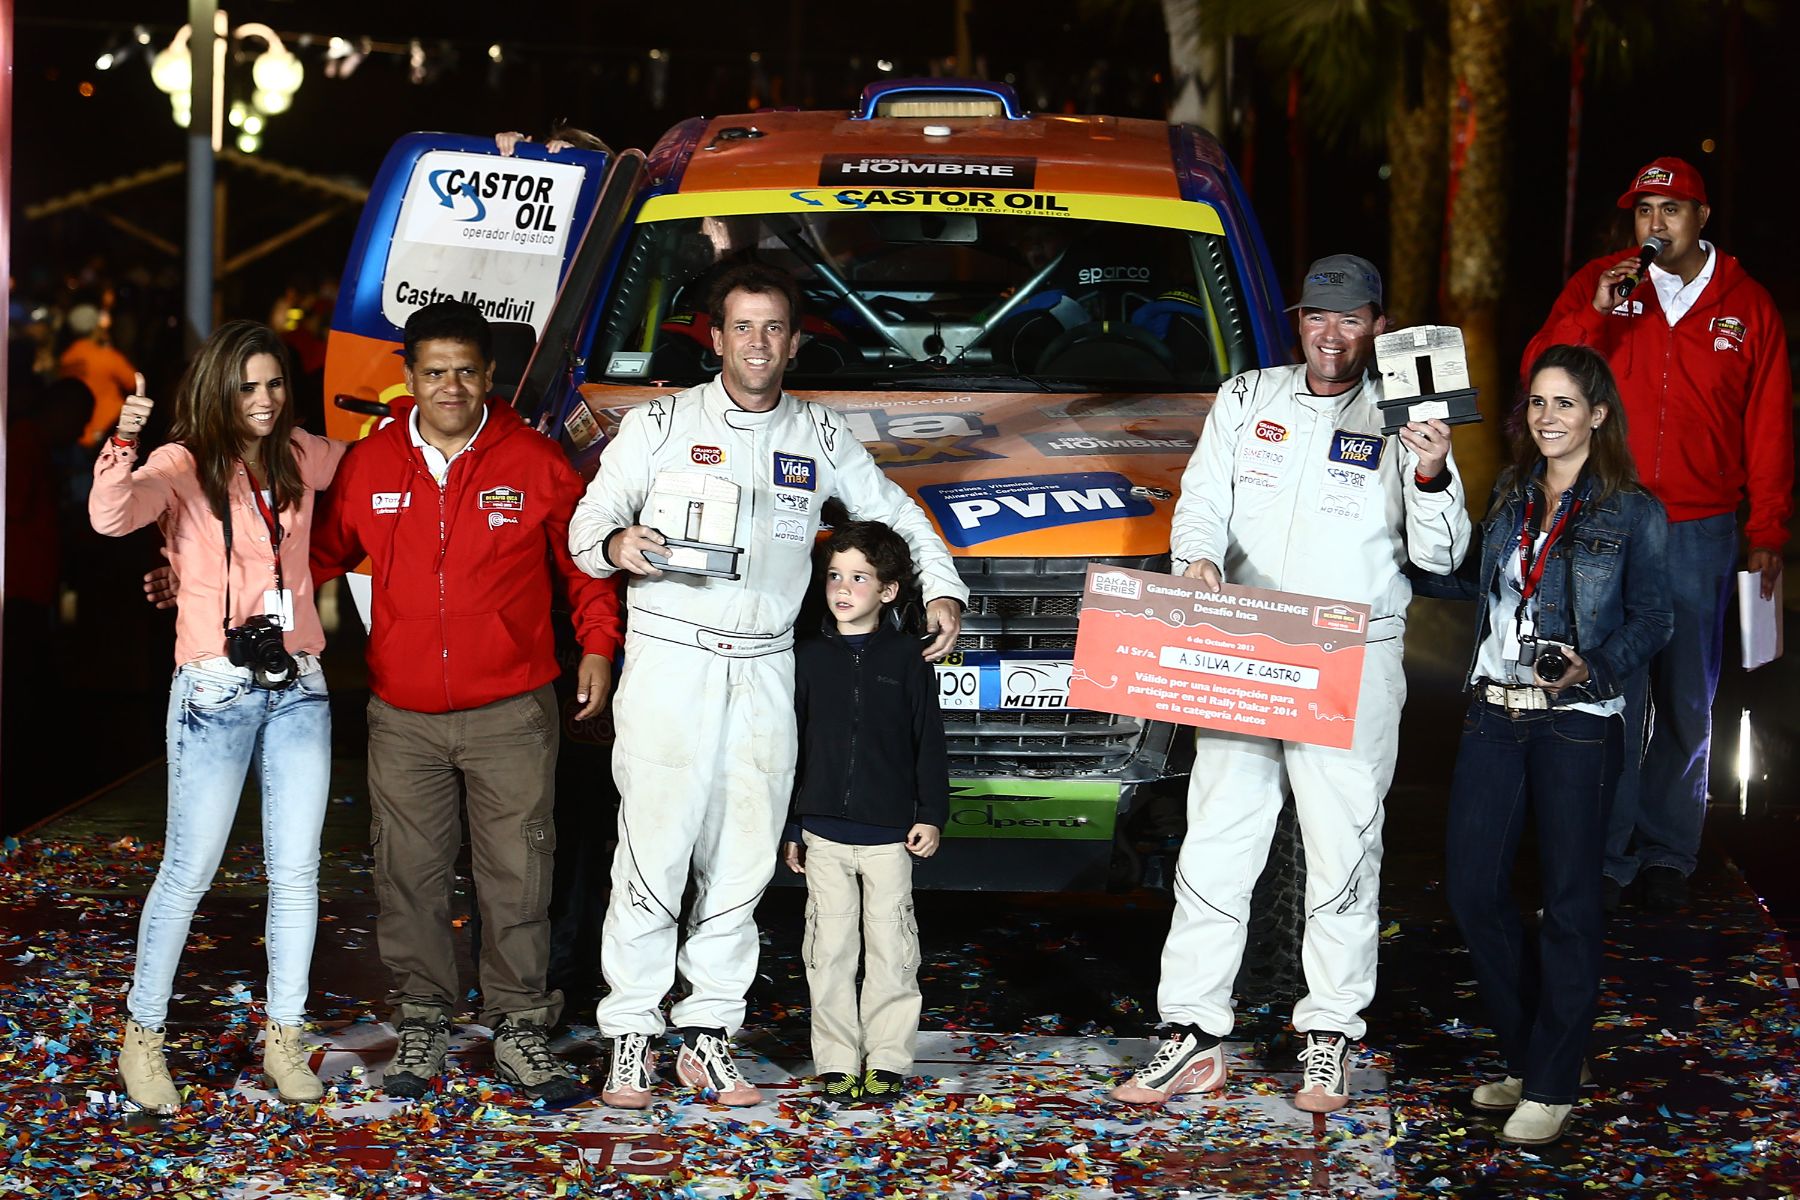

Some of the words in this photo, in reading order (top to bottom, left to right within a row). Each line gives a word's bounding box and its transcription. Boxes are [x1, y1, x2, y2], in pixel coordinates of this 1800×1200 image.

[841, 163, 1014, 177] HOMBRE
[447, 169, 554, 203] CASTOR
[837, 190, 988, 207] CASTOR
[1004, 192, 1069, 212] OIL
[515, 203, 557, 232] OIL
[462, 227, 510, 242] operador
[1079, 267, 1150, 284] sparco
[461, 291, 535, 323] Mendivil
[846, 396, 972, 408] balanceada
[1257, 428, 1283, 443] ORO
[1048, 439, 1193, 451] HOMBRE
[1340, 439, 1373, 455] Vida
[693, 453, 721, 465] ORO
[1341, 451, 1368, 462] max
[779, 461, 810, 477] Vida
[1334, 469, 1366, 481] CASTOR
[785, 474, 808, 484] max
[1351, 478, 1364, 486] OIL
[995, 485, 1060, 494] Carbohidratos
[782, 494, 810, 505] CASTOR
[798, 502, 808, 510] OIL
[949, 488, 1126, 529] PVM
[774, 533, 805, 542] MOTODIS
[1096, 574, 1137, 588] DAKAR
[1096, 583, 1136, 596] SERIES
[1146, 584, 1193, 599] Ganador
[1194, 590, 1236, 605] DAKAR
[1238, 596, 1309, 616] CHALLENGE
[1236, 610, 1258, 622] Inca
[1204, 639, 1236, 649] Octubre
[1116, 644, 1130, 655] Al
[1131, 647, 1157, 659] Sr/a.
[1135, 671, 1168, 685] Válido
[1170, 677, 1188, 690] por
[1190, 681, 1211, 692] una
[1212, 682, 1268, 702] inscripción
[1270, 692, 1294, 705] para
[1004, 695, 1068, 707] MOTO
[1127, 684, 1179, 701] participar
[1181, 691, 1195, 702] en
[1196, 692, 1207, 703] el
[1209, 695, 1236, 711] Rally
[1238, 699, 1270, 714] Dakar
[1272, 706, 1297, 718] 2014
[1156, 701, 1170, 711] en
[1171, 702, 1181, 712] la
[1183, 704, 1232, 722] categoría
[1233, 712, 1266, 726] Autos
